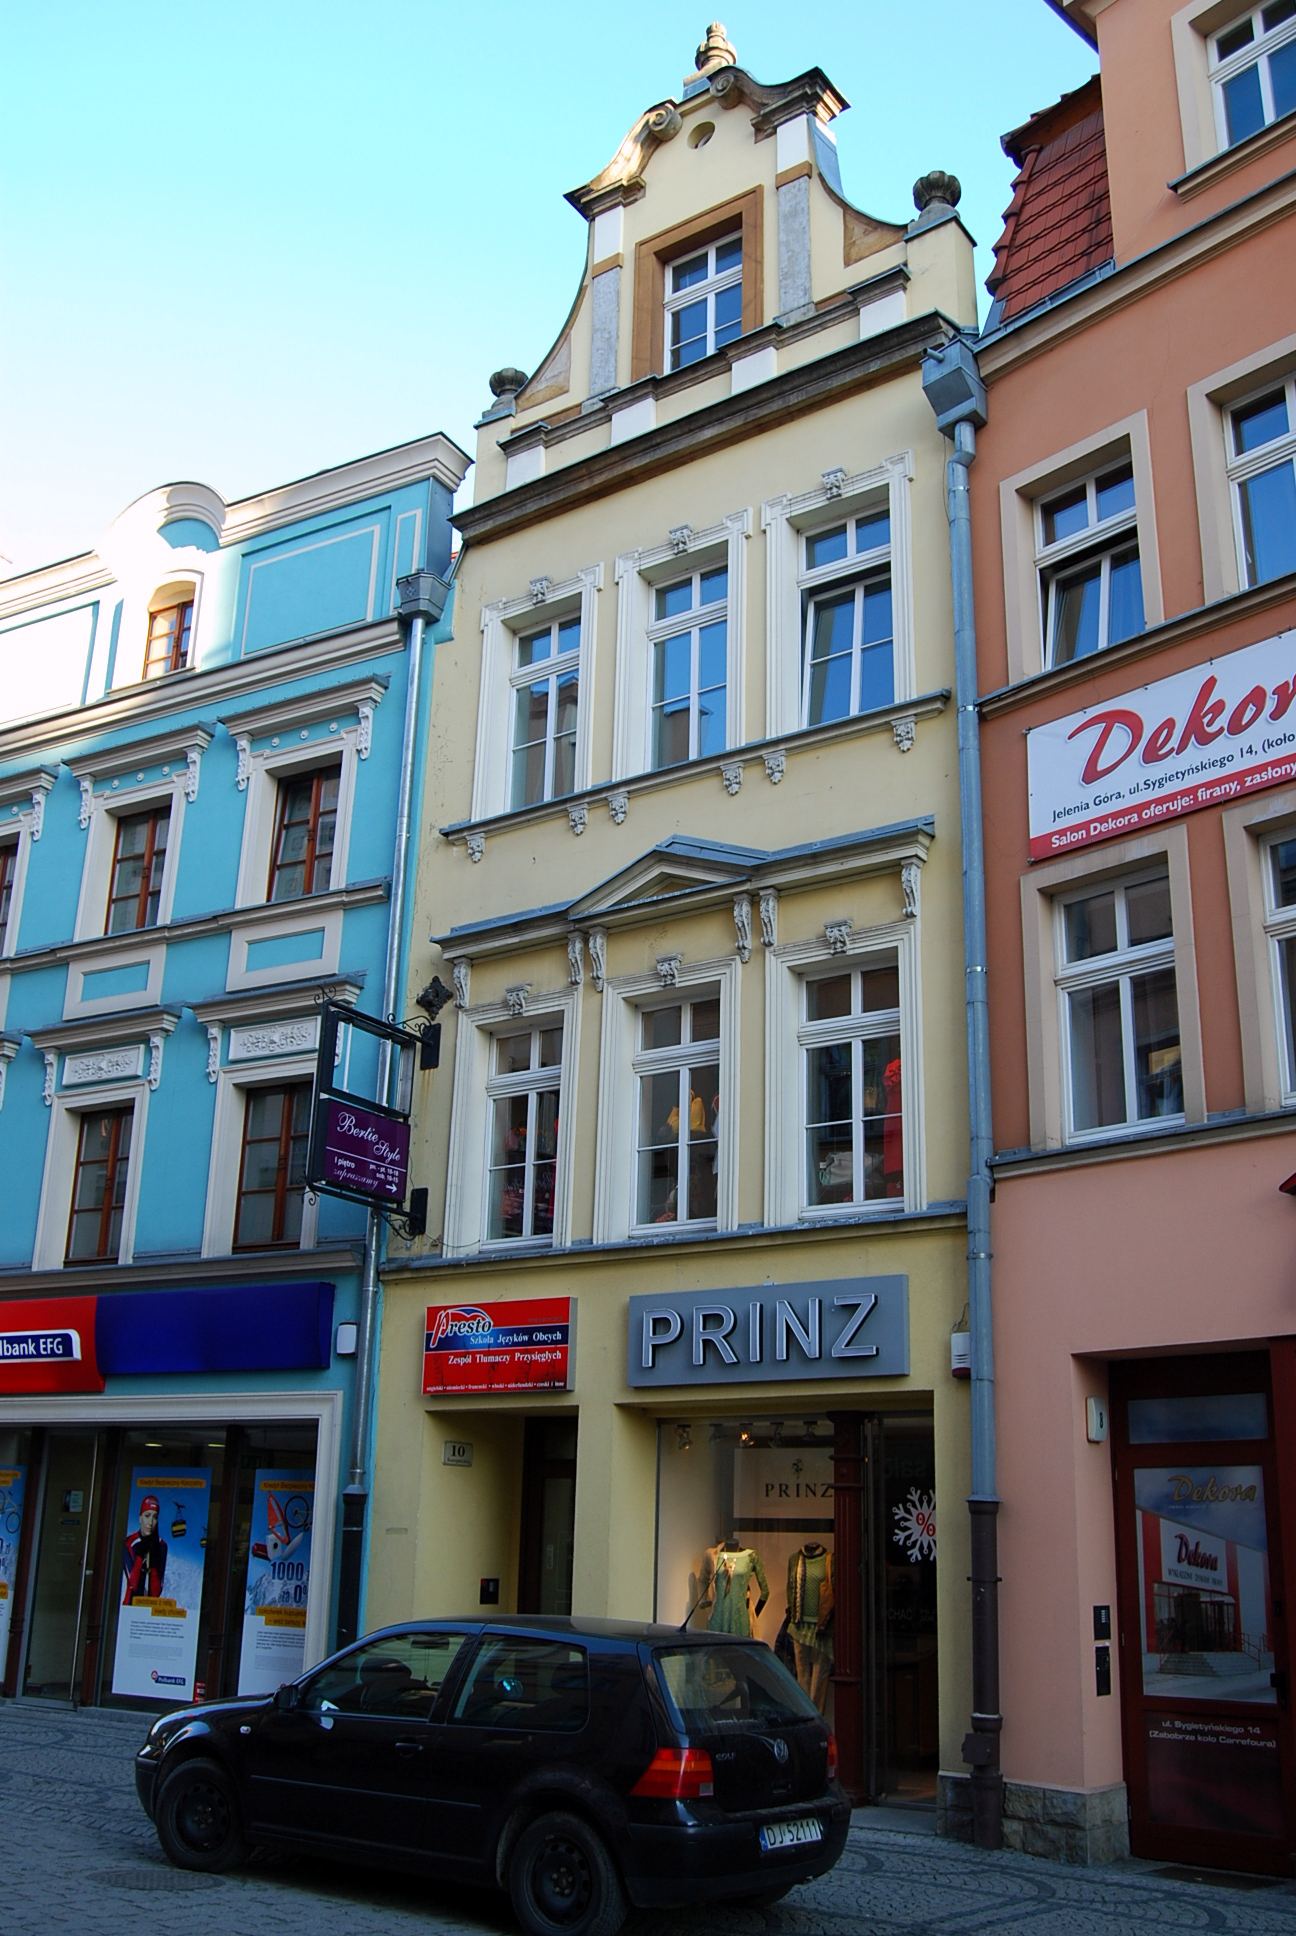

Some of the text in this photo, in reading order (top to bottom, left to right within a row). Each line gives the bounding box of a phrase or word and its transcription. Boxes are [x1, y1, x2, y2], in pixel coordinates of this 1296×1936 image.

[1052, 731, 1296, 824] Jelenia Góra, ul.Sygietyńskiego 14, (koło
[1051, 828, 1087, 851] Salon
[1090, 811, 1139, 839] Dekora
[1142, 794, 1195, 822] oferuje:
[1198, 780, 1241, 806] firany,
[373, 1140, 401, 1164] Style
[338, 1158, 356, 1169] piętro
[430, 1308, 494, 1349] Presto
[497, 1333, 529, 1346] Języków
[533, 1331, 563, 1343] Obcych
[641, 1293, 880, 1368] PRINZ
[39, 1337, 64, 1355] EFG
[448, 1350, 562, 1366] Zespół Tłumaczy Przysięgłych
[1098, 1411, 1105, 1430] 8
[451, 1445, 466, 1458] 10
[764, 1482, 833, 1498] PRINZ
[1167, 1474, 1257, 1503] Dekora
[1174, 1533, 1219, 1572] Dekora
[271, 1561, 304, 1581] 1000
[1247, 1726, 1261, 1735] 14
[766, 1819, 821, 1847] DJ 52111
